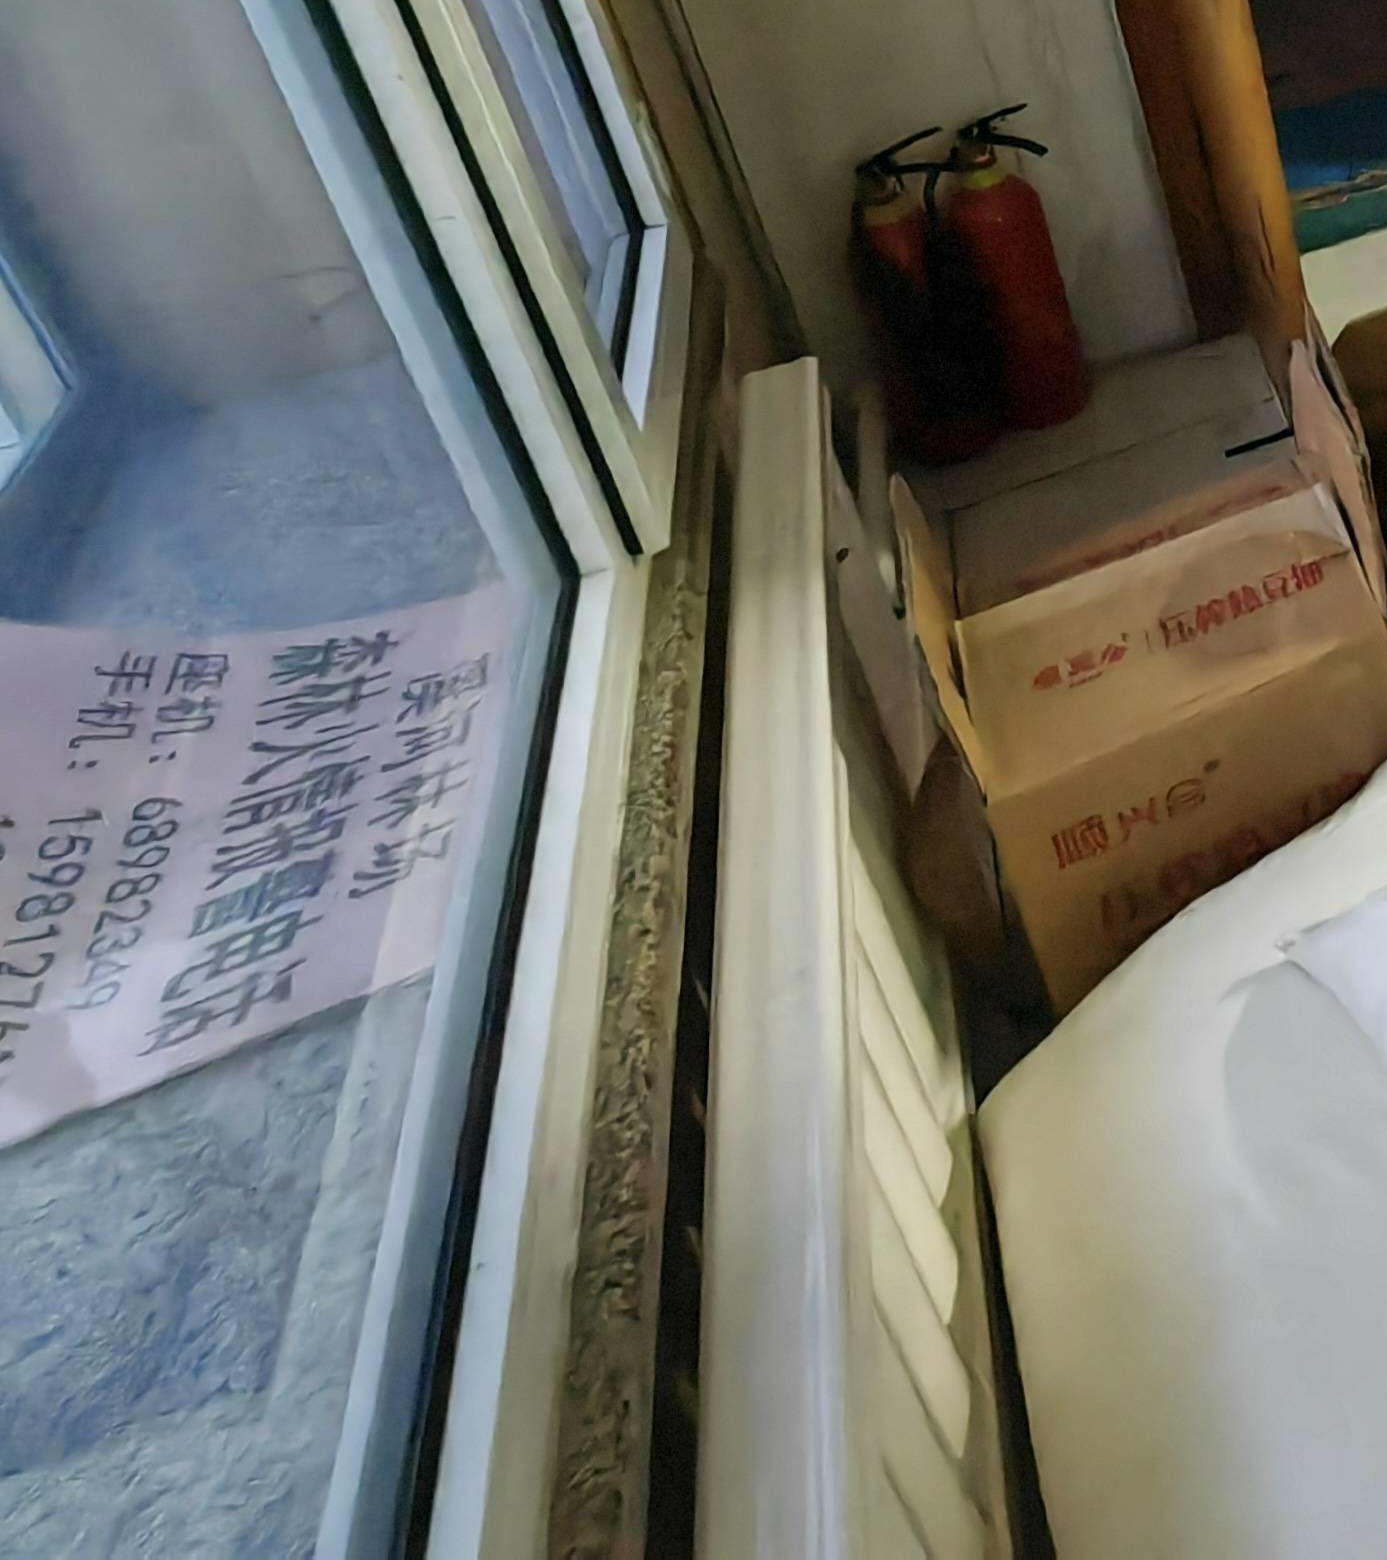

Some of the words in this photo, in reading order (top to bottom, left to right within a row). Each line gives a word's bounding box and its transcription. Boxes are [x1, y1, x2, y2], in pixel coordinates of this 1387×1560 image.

[137, 630, 399, 1057] 森林火情报警电话
